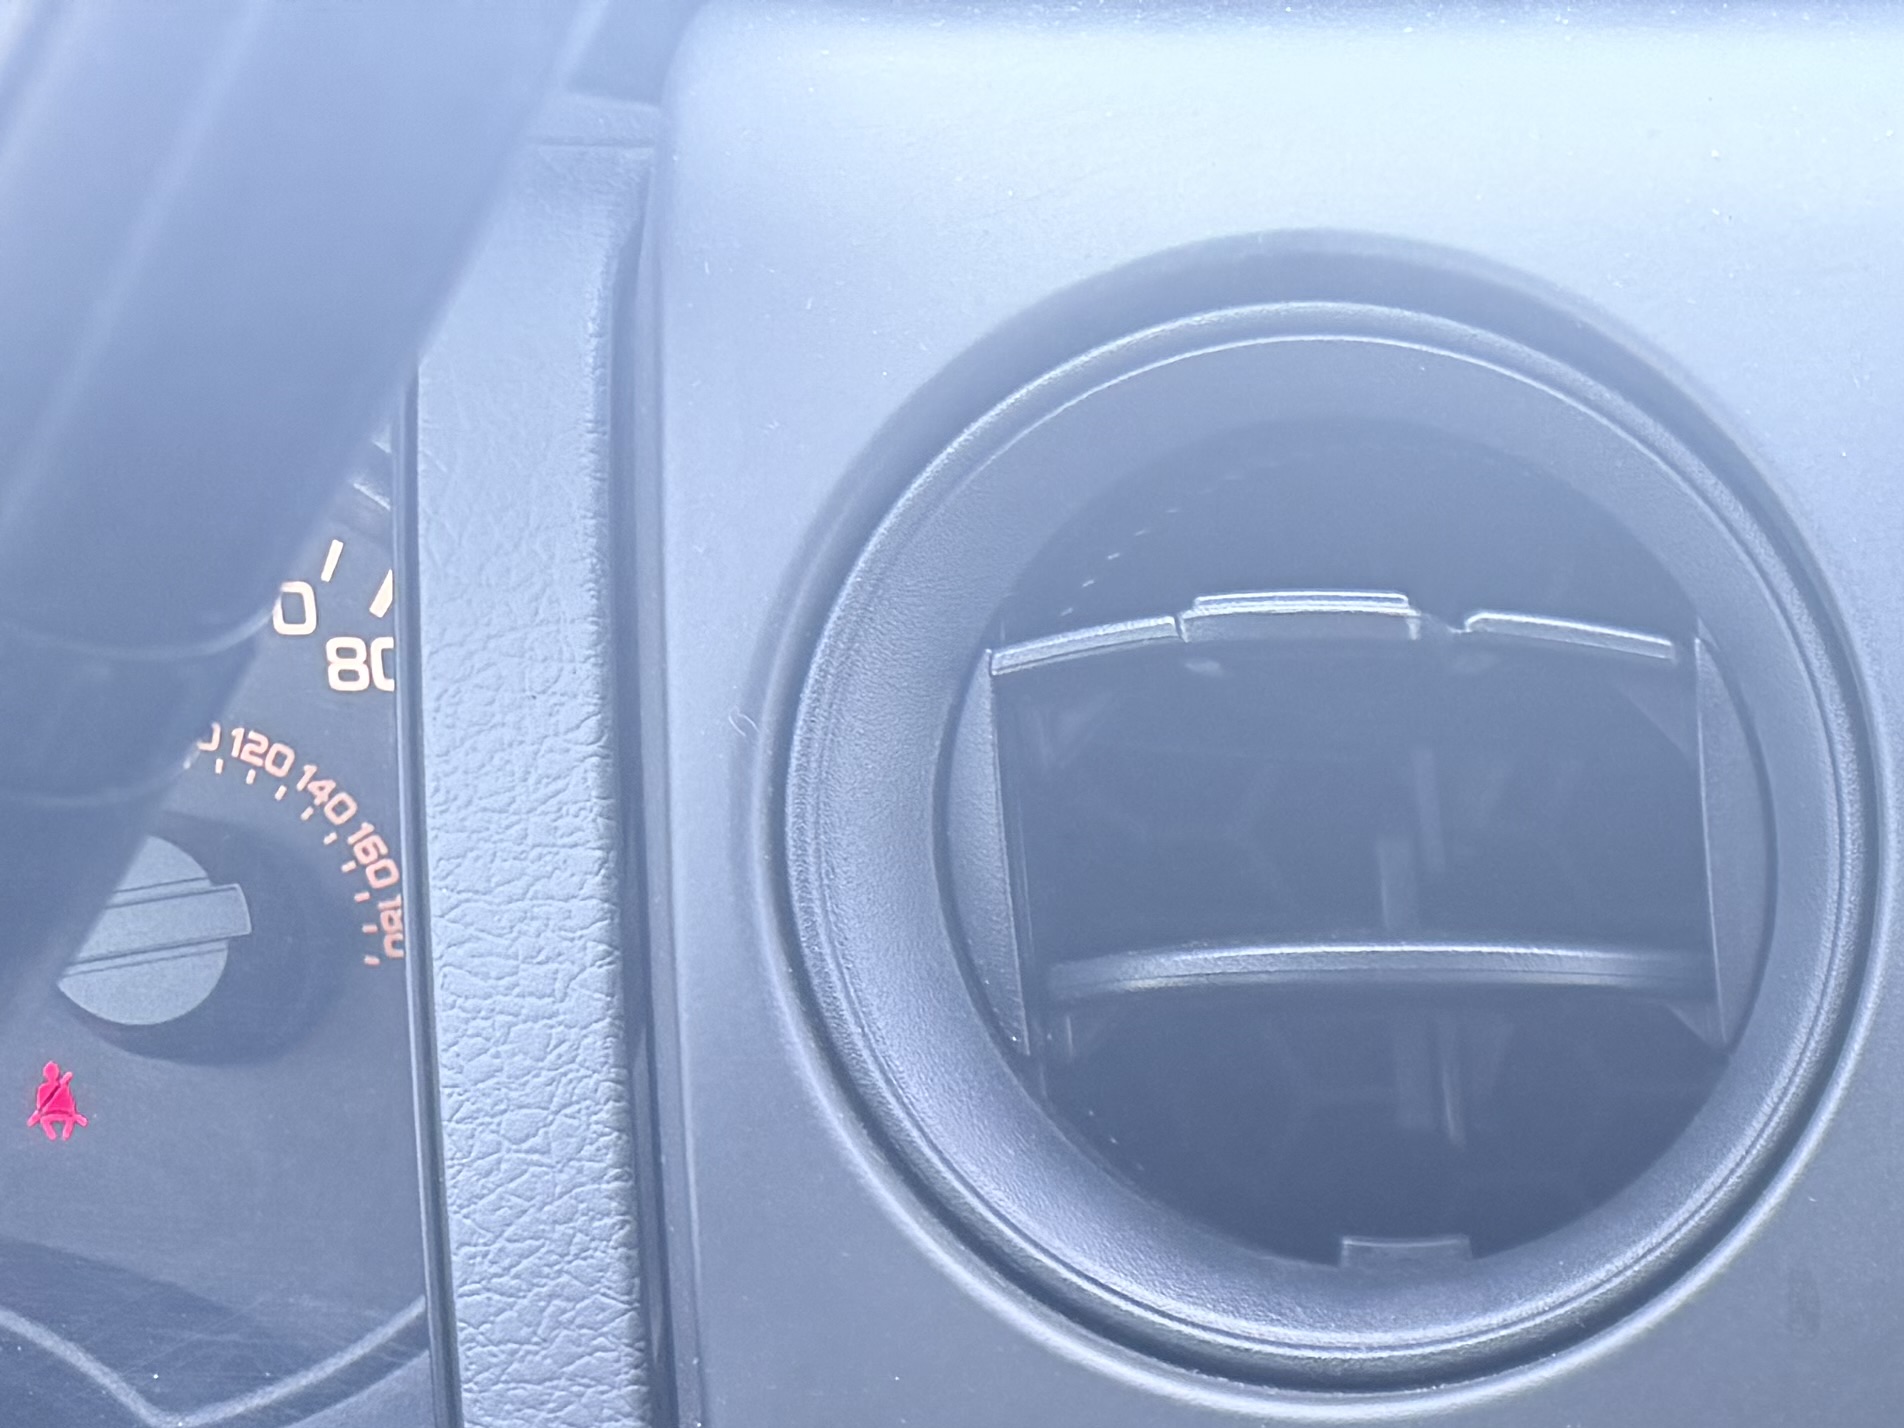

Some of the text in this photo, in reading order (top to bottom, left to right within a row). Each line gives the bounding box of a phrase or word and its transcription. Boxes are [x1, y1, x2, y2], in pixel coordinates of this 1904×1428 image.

[272, 581, 318, 636] 0
[230, 726, 296, 778] 120
[296, 764, 358, 826] 140
[346, 822, 400, 889] 160
